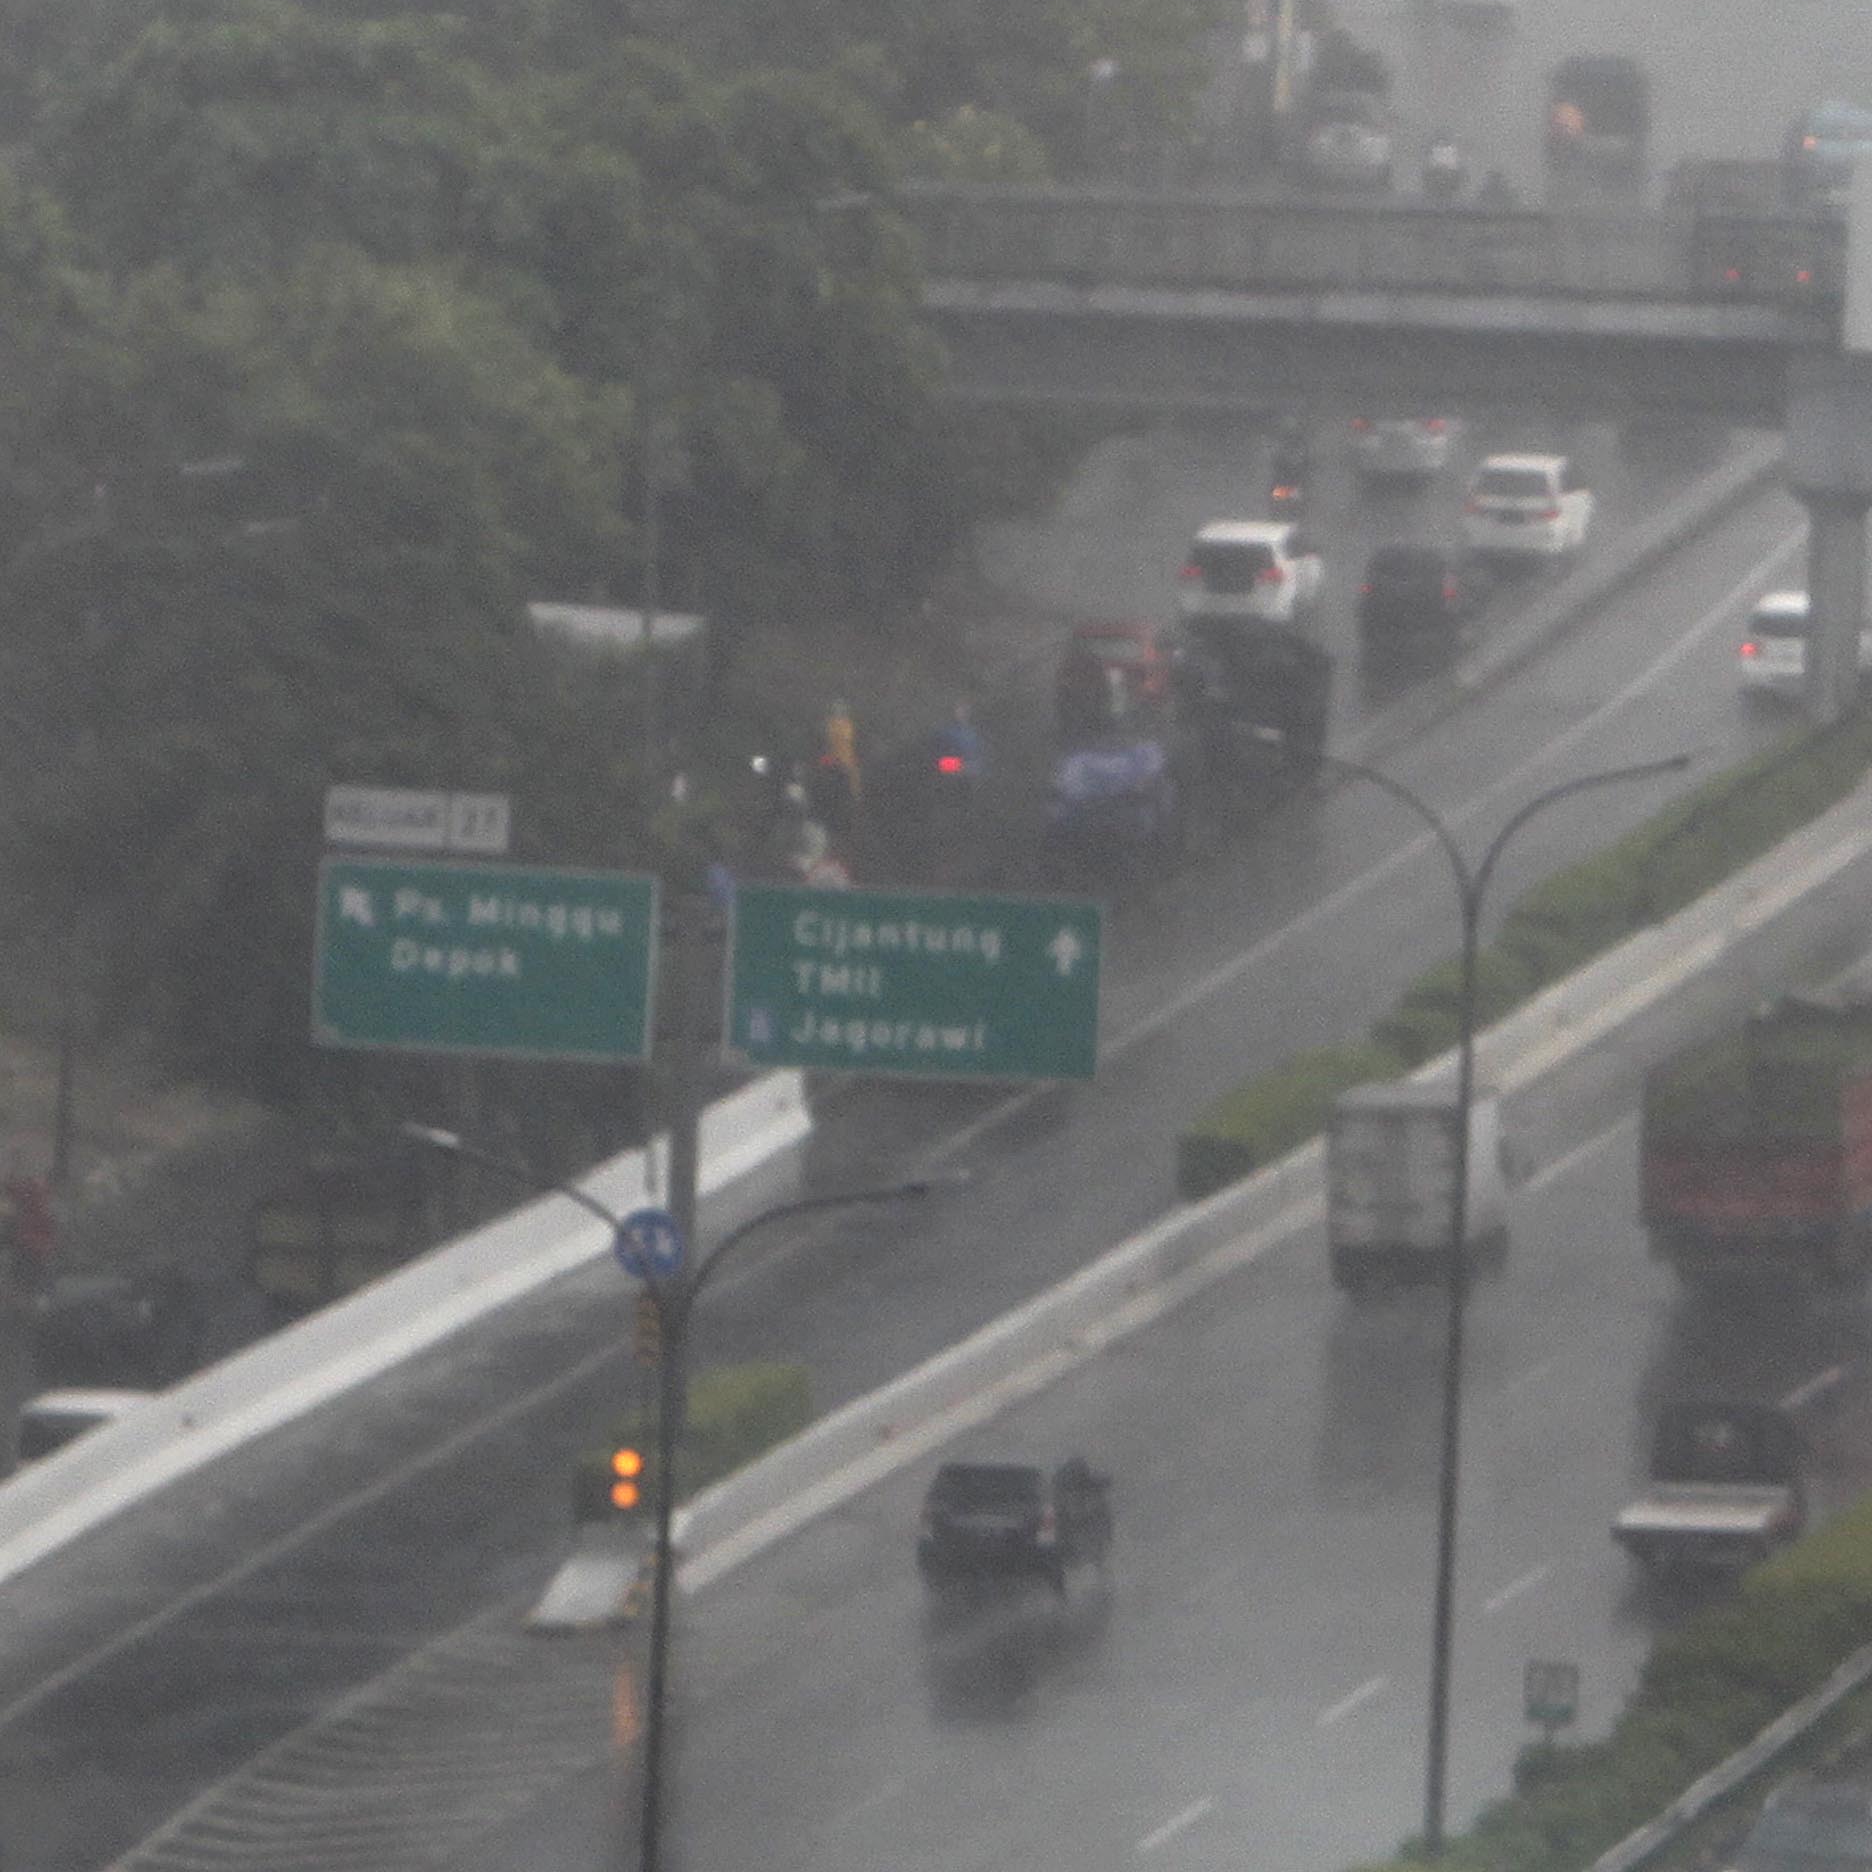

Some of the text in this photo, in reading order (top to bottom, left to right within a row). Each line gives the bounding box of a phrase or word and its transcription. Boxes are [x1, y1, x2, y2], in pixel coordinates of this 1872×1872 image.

[466, 894, 624, 940] Minggu
[794, 910, 1002, 963] Cijantung
[392, 938, 522, 976] Depok
[792, 1012, 986, 1052] Jagorawi
